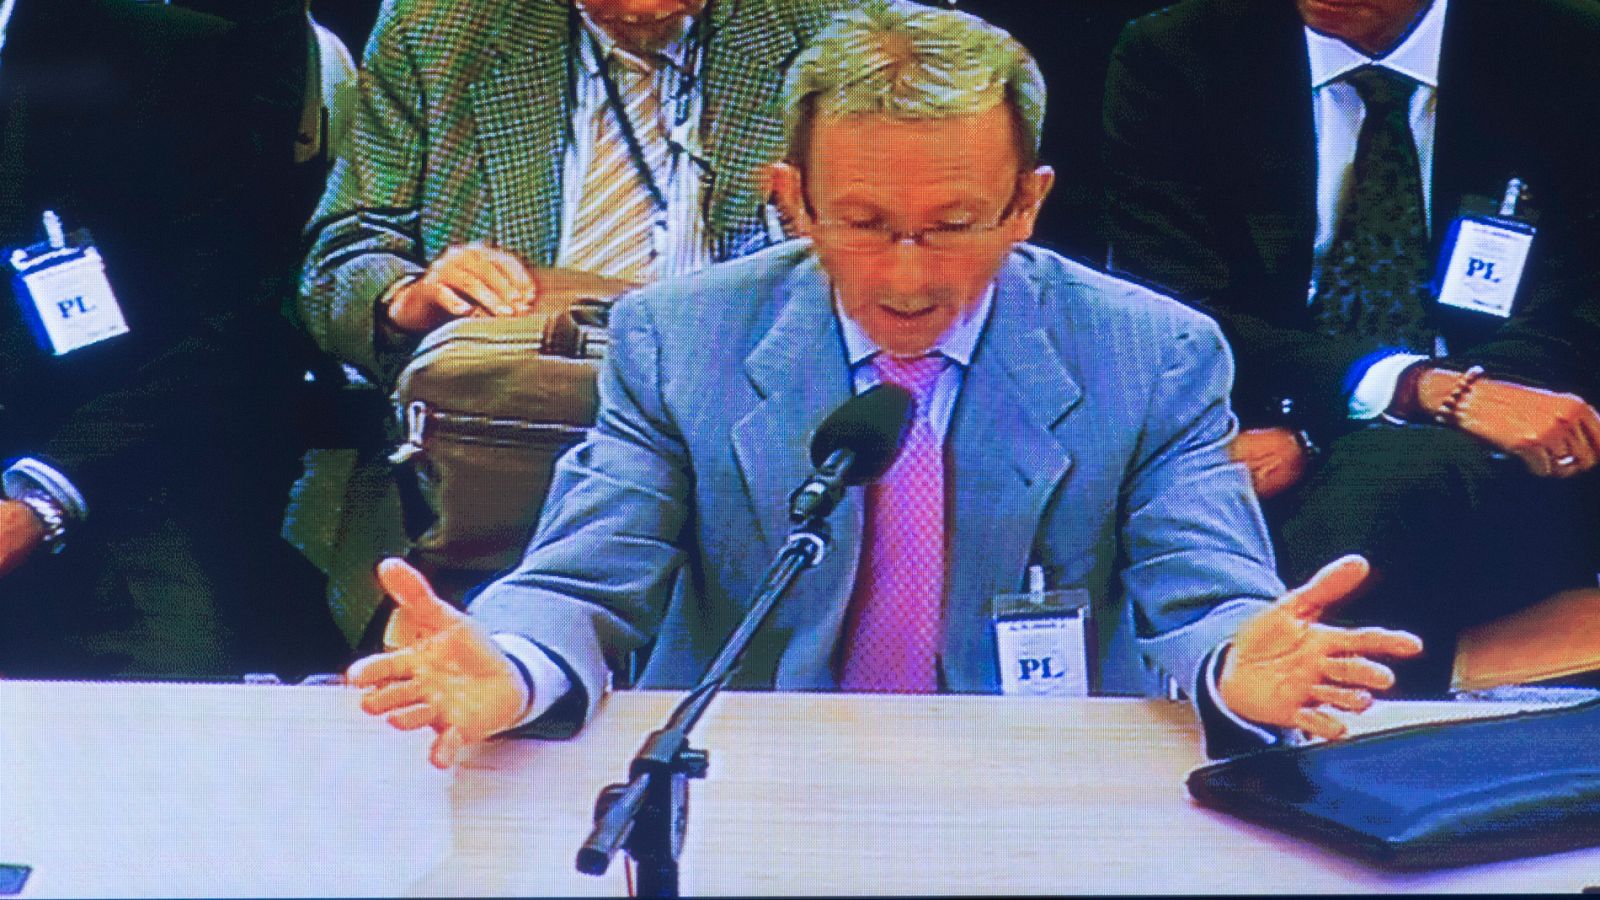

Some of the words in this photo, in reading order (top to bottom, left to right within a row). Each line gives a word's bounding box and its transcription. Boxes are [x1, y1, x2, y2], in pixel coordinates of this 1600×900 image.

[1465, 256, 1501, 284] PL
[56, 294, 97, 319] PL
[1017, 656, 1066, 680] PL
